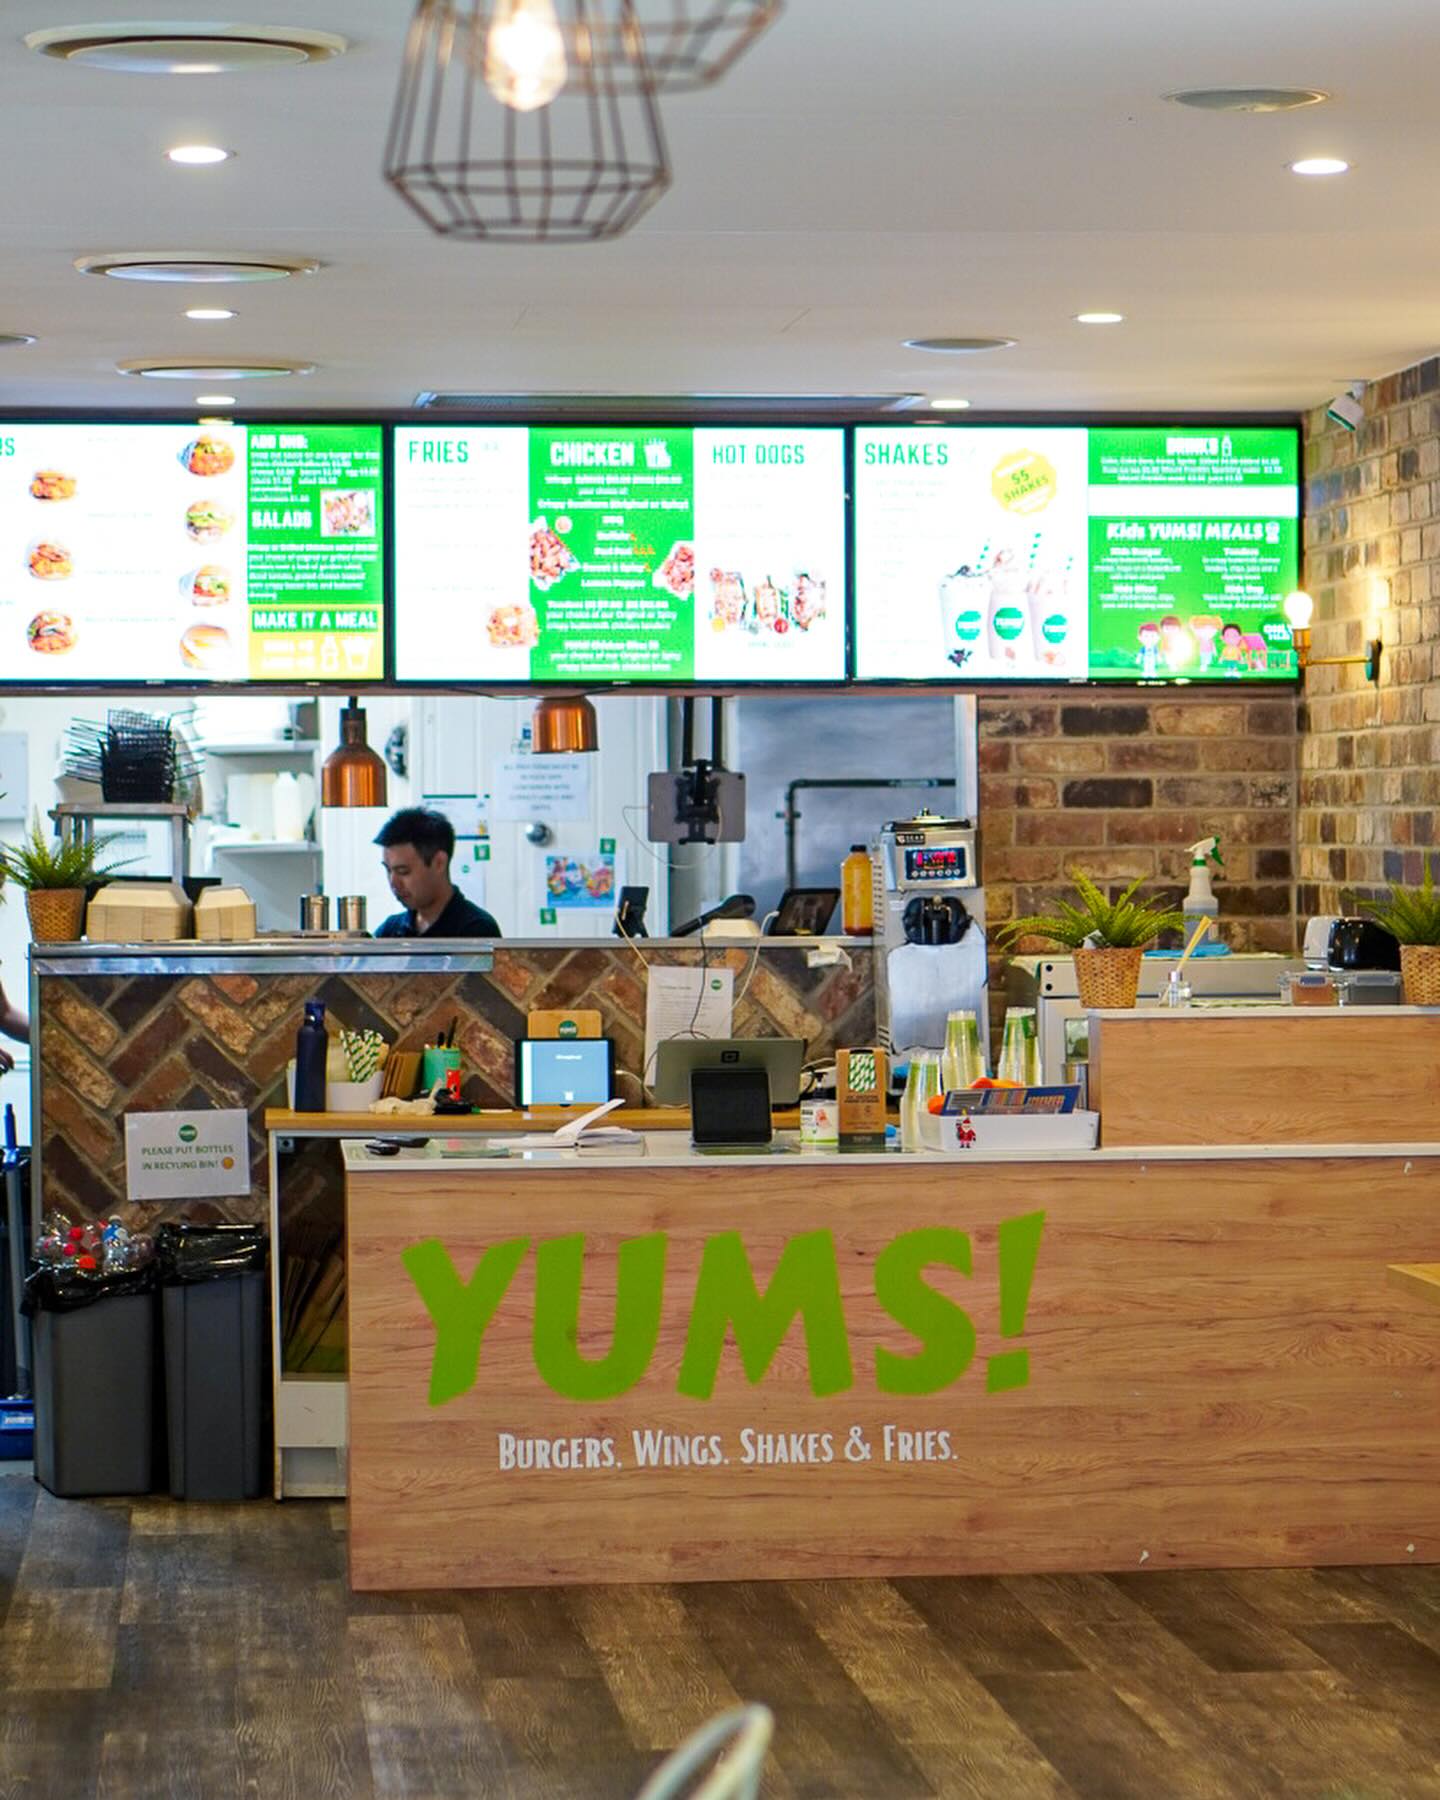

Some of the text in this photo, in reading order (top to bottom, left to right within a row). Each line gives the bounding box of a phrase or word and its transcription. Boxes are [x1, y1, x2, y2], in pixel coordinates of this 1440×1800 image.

[408, 440, 470, 465] FRIES
[550, 441, 635, 467] CHICKEN
[712, 444, 806, 465] HOT DOGS
[864, 441, 949, 466] SHAKES
[252, 510, 312, 528] SALADS
[1106, 522, 1264, 540] Kids YUMS! MEALS
[254, 611, 378, 629] MAKE IT A MEAL
[141, 1144, 234, 1156] PLEASE PUT BOTTLES
[143, 1160, 218, 1170] IN RECYLING BIN!
[400, 1209, 1046, 1408] YUMS!
[740, 1427, 834, 1464] SHAKES
[844, 1425, 872, 1462] &
[883, 1425, 958, 1462] FRIES.
